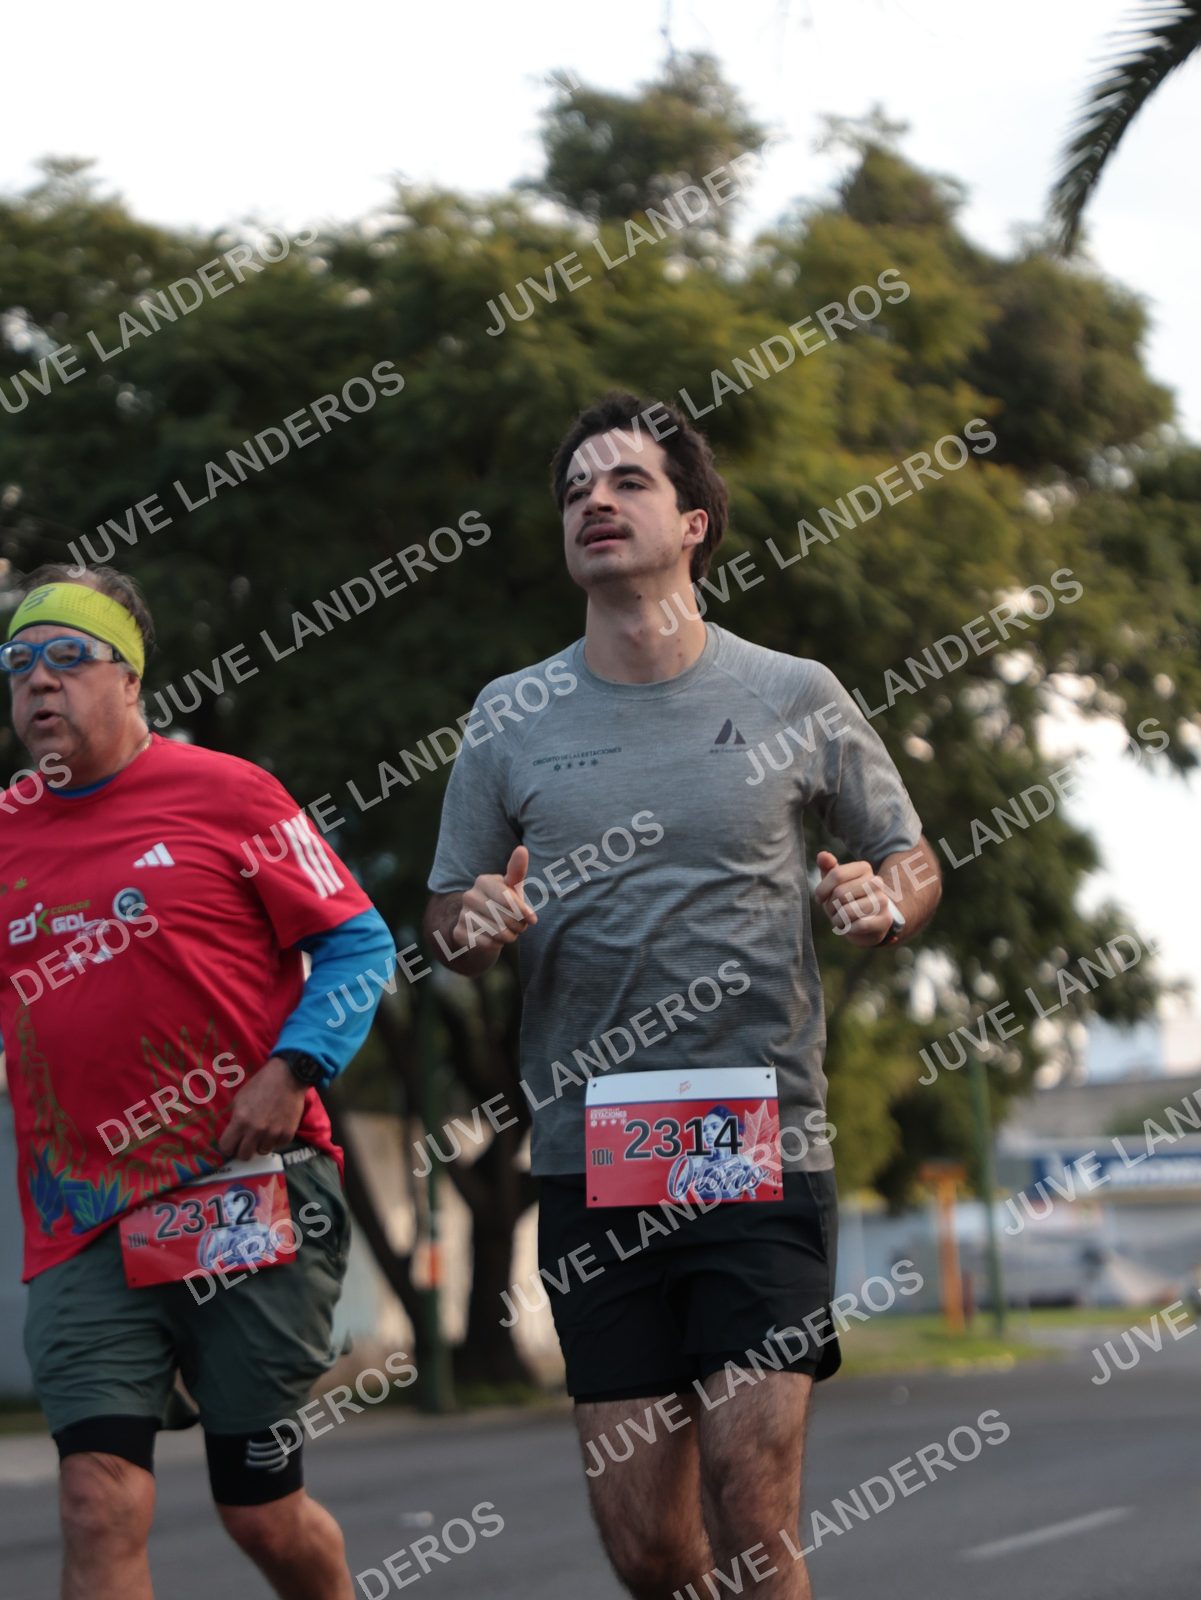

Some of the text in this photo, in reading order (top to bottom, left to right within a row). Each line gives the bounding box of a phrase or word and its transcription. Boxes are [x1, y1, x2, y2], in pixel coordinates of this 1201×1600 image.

[591, 1149, 614, 1166] 10k
[623, 1115, 744, 1160] 2314
[154, 1190, 259, 1241] 2312
